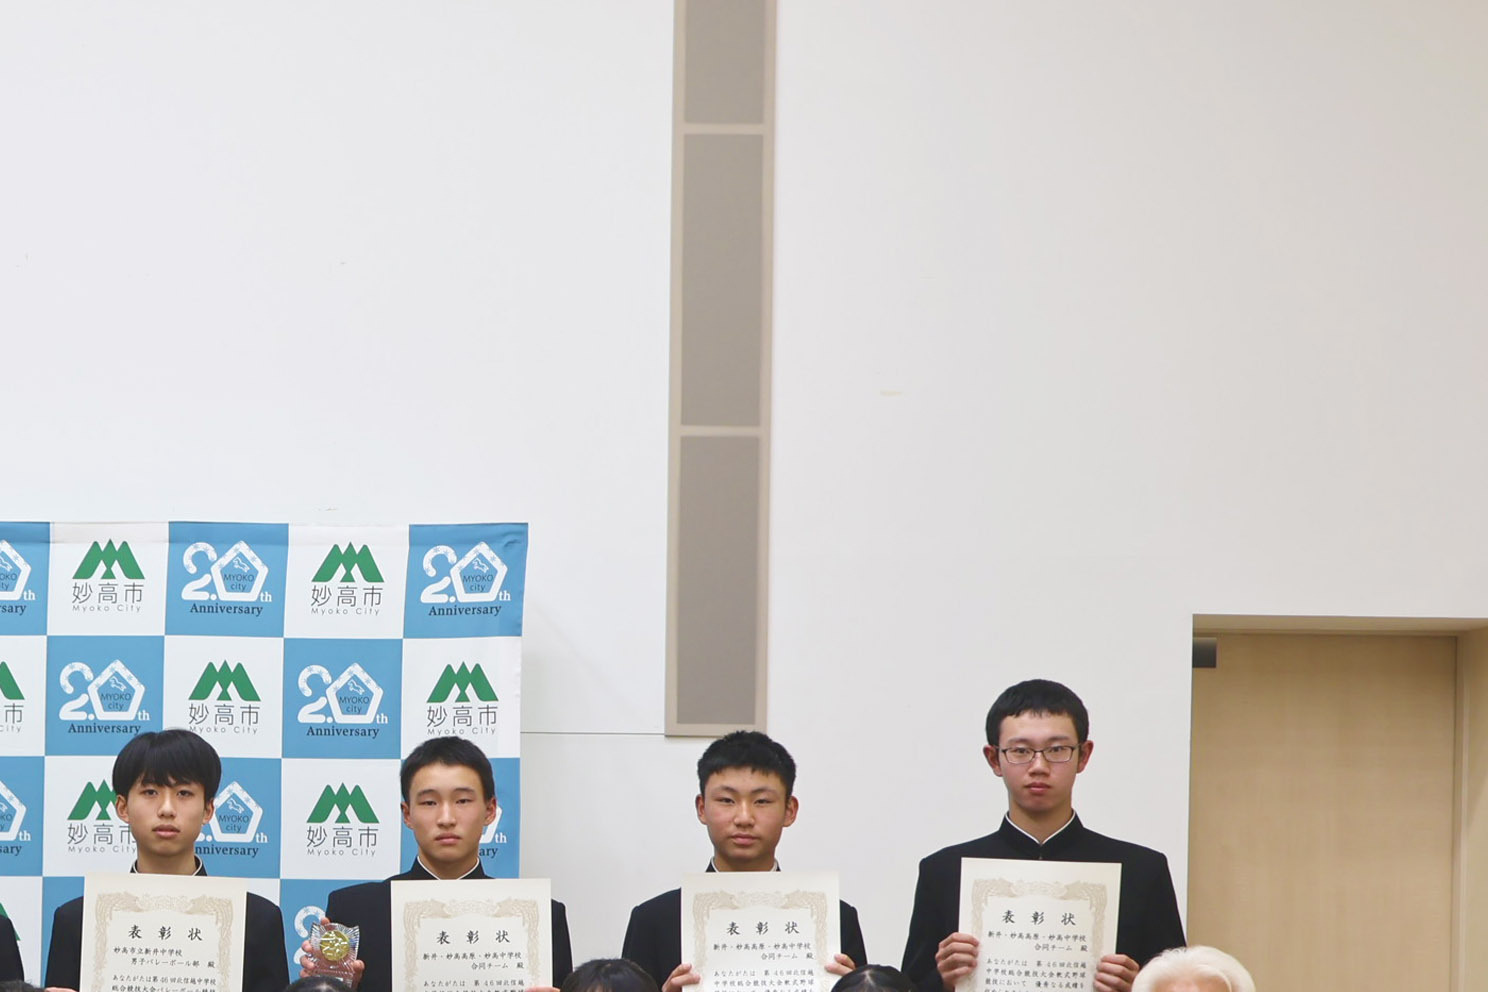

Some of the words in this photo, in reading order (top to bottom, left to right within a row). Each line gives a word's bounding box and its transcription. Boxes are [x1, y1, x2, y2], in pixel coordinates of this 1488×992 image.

[224, 573, 254, 582] MYOKO
[462, 574, 493, 583] MYOKO
[231, 582, 247, 592] city
[470, 582, 486, 591] city
[72, 582, 143, 604] 妙高市
[311, 585, 382, 607] 妙高市
[73, 604, 109, 613] Myoko
[117, 604, 141, 613] City
[190, 603, 263, 617] Anniversary
[312, 607, 348, 616] Myoko
[356, 607, 380, 616] City
[428, 604, 501, 618] Anniversary
[101, 692, 131, 701] MYOKO
[339, 696, 370, 704] MYOKO
[108, 701, 124, 711] city
[346, 704, 362, 714] city
[188, 703, 260, 727] 妙高市
[427, 705, 498, 727] 妙高市
[68, 722, 141, 735] Anniversary
[190, 725, 226, 734] Myoko
[233, 725, 258, 735] City
[307, 725, 380, 739] Anniversary
[428, 727, 464, 736] Myoko
[471, 727, 497, 736] City
[219, 814, 249, 824] MYOKO
[226, 823, 242, 833] city
[306, 826, 378, 848] 妙高市
[68, 844, 105, 854] Myoko
[112, 844, 136, 854] City
[194, 845, 258, 857] nniversary
[307, 848, 344, 856] Myoko
[351, 848, 376, 857] City
[1002, 909, 1076, 926] 表彰状
[128, 924, 203, 941] 表彰状
[726, 921, 800, 936] 表彰状
[436, 930, 511, 945] 表彰状
